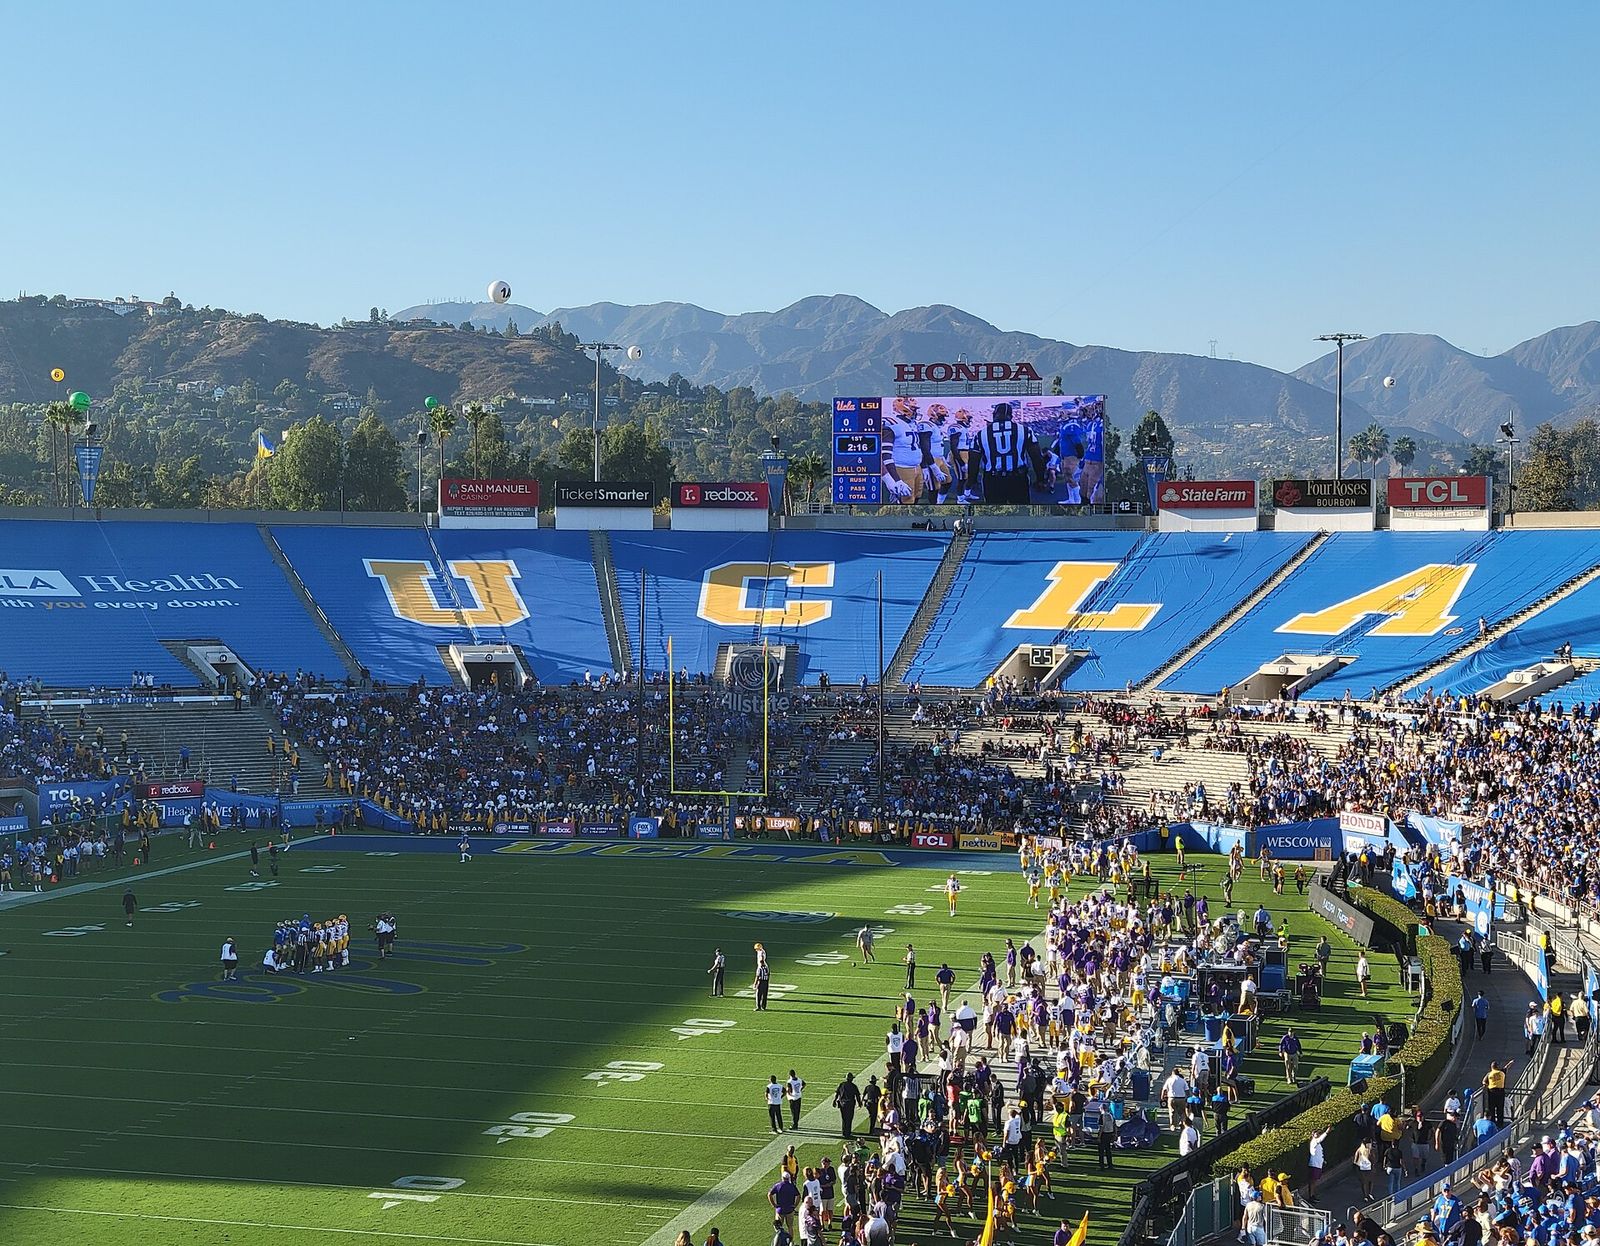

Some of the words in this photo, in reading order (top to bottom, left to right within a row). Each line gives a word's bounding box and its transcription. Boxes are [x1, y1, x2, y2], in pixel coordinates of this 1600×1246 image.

[893, 362, 1042, 382] HONDA
[843, 418, 849, 426] 0
[867, 418, 874, 426] 0
[847, 443, 868, 452] 2:16
[461, 484, 483, 494] SAN
[485, 484, 531, 494] MANUEL
[560, 488, 650, 501] TicketSmarter
[704, 488, 759, 502] redbox.
[1404, 481, 1468, 503] TCL
[1119, 501, 1130, 511] 42
[1316, 498, 1356, 507] BOURBON
[78, 572, 244, 594] Health
[0, 599, 35, 609] ith
[41, 600, 88, 610] you
[93, 600, 159, 610] every
[166, 598, 241, 609] down.
[1032, 649, 1052, 665] 25
[637, 823, 649, 831] FOX
[1341, 813, 1383, 832] HONDA
[915, 835, 948, 847] TCL
[961, 837, 998, 849] nextiva
[1266, 836, 1319, 848] WESCOM
[581, 1060, 666, 1083] 30
[480, 1111, 577, 1139] 20
[366, 1174, 467, 1203] 10
